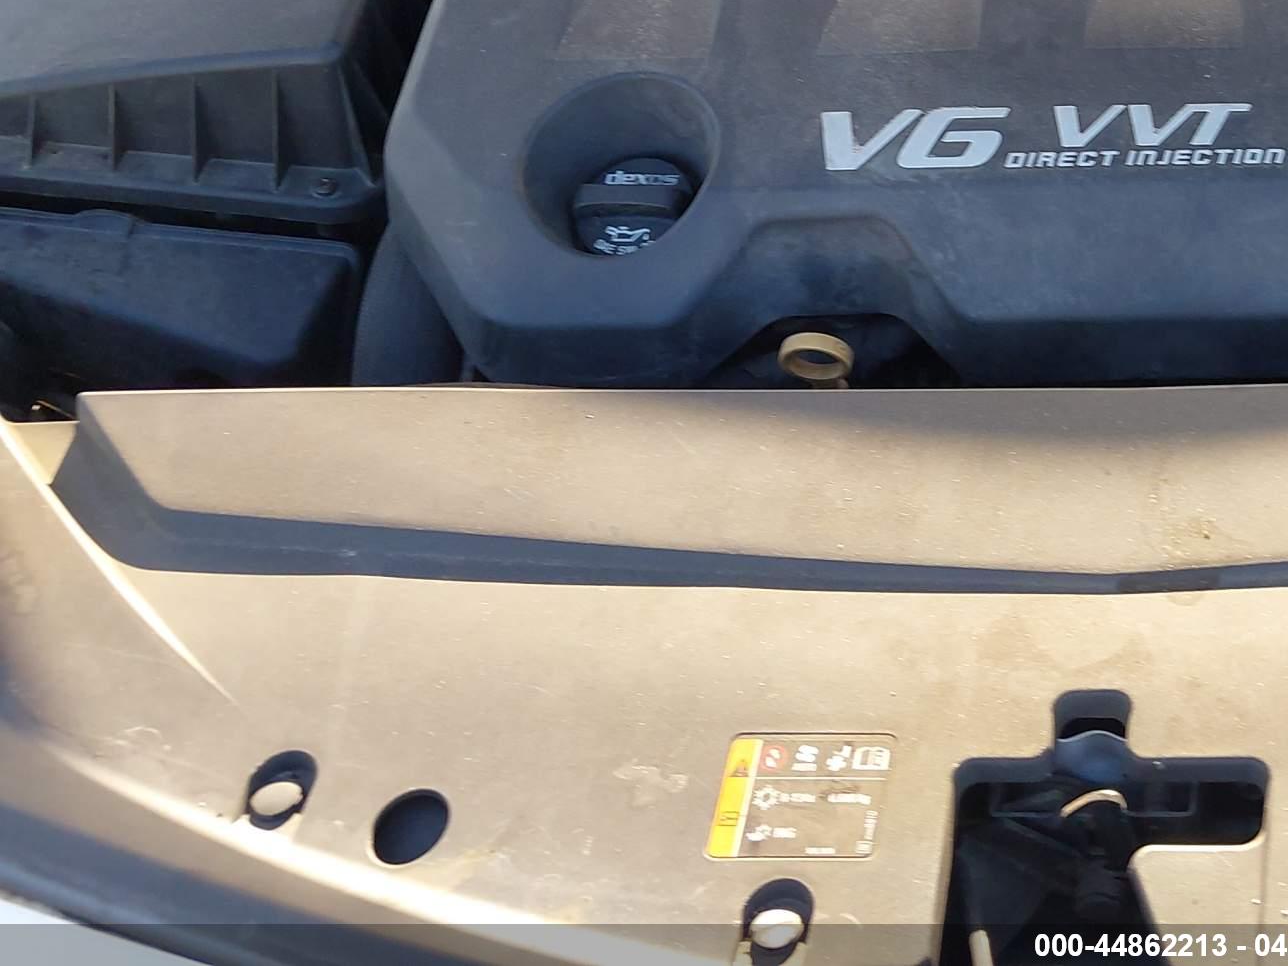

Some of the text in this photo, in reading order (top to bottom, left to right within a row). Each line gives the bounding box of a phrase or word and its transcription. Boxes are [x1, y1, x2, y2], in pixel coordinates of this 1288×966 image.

[820, 107, 1011, 170] V6
[1053, 103, 1253, 147] VVT
[1004, 148, 1286, 168] DIRECT INJECTION
[605, 170, 680, 185] dexos
